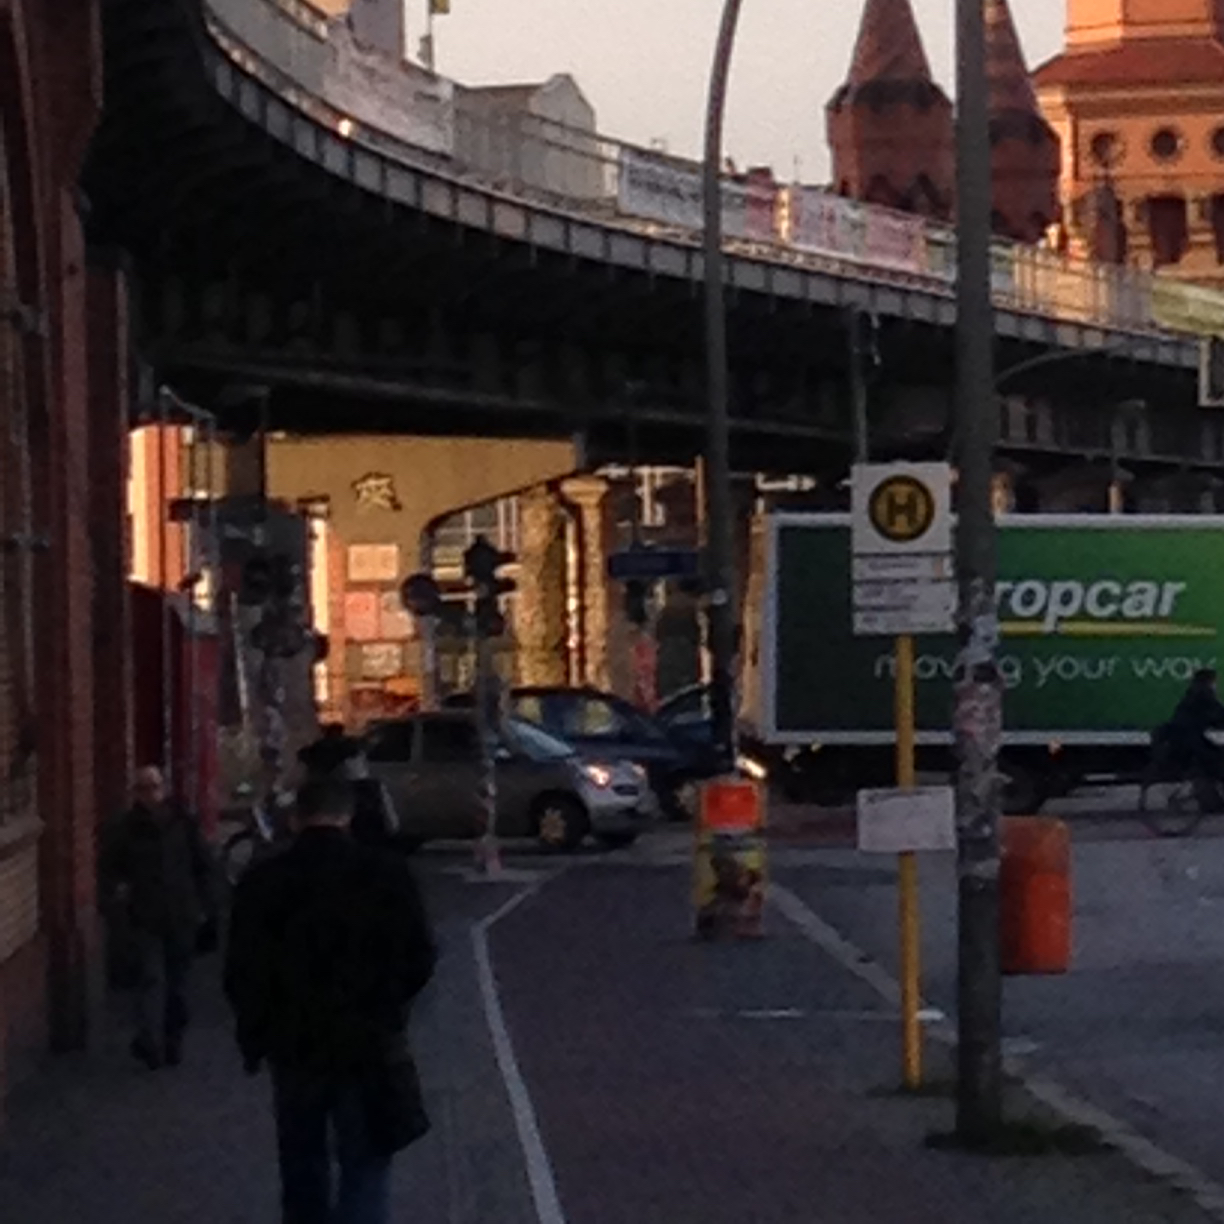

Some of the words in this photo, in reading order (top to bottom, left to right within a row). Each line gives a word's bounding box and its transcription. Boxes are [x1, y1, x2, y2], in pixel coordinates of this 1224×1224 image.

[887, 490, 919, 526] H
[994, 580, 1187, 632] ropcar
[874, 654, 1022, 688] movg
[1034, 656, 1121, 687] your
